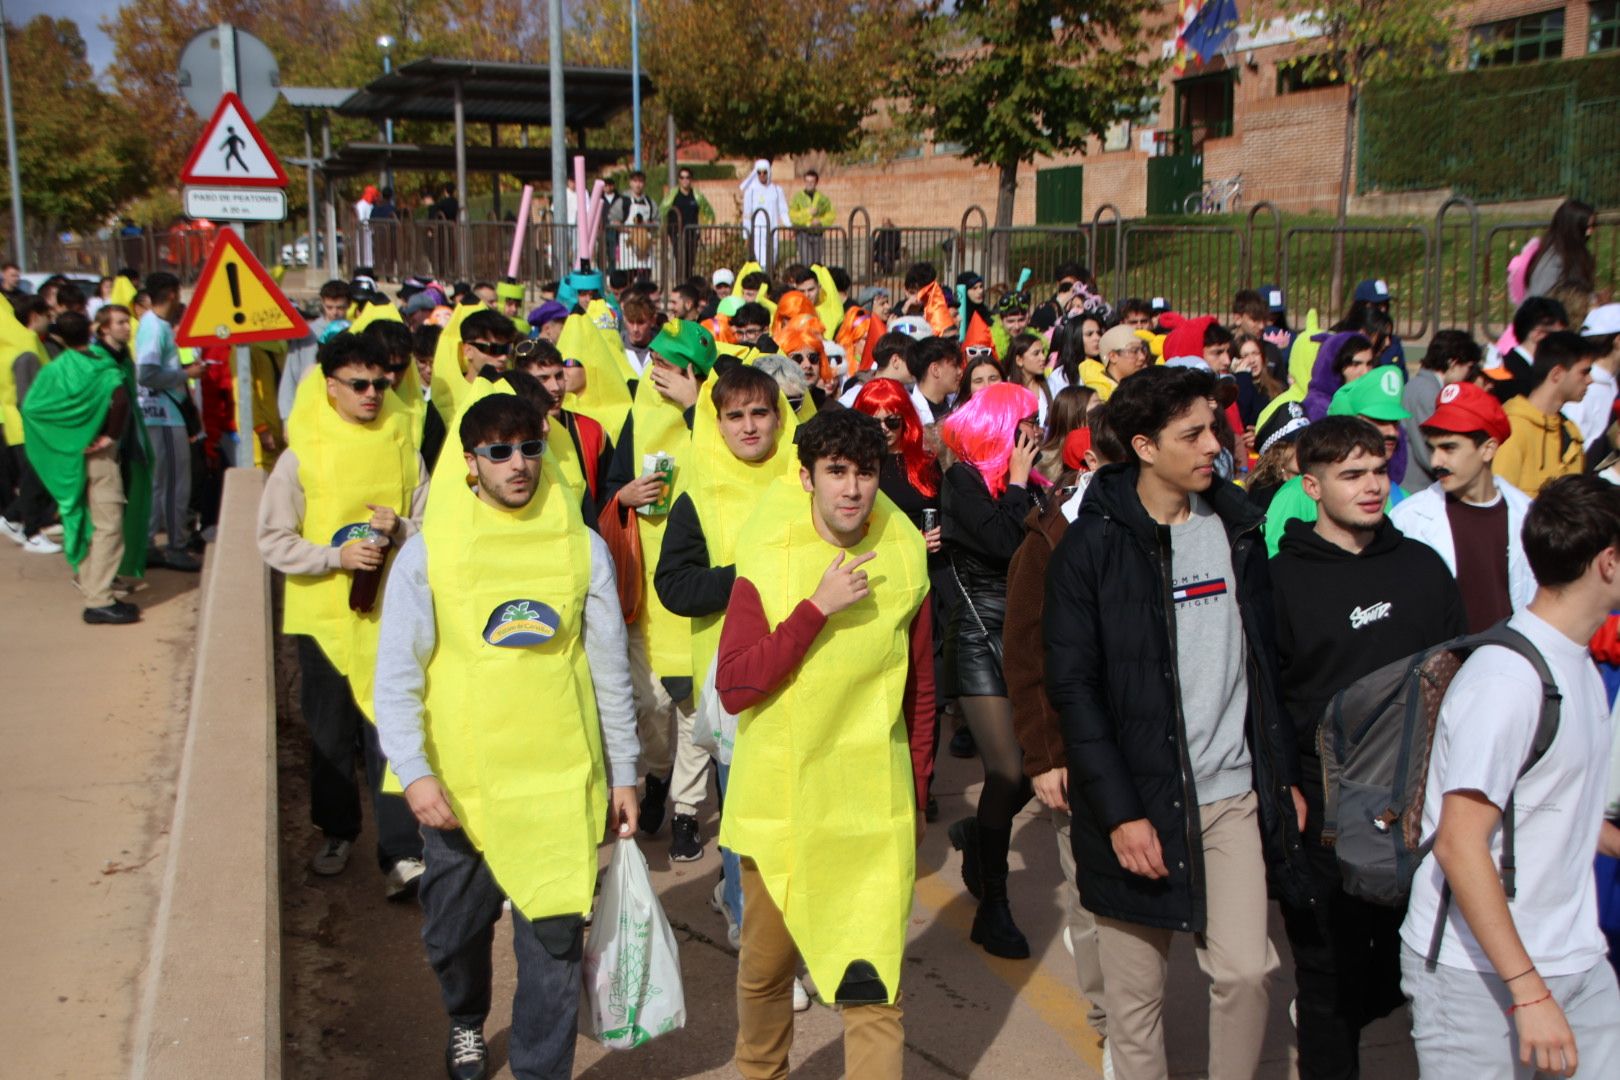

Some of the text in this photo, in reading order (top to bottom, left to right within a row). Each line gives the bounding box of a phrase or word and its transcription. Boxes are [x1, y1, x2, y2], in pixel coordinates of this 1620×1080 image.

[193, 193, 278, 203] PASO DE PEATONES
[1387, 373, 1396, 393] L
[1444, 386, 1456, 398] M
[1172, 573, 1209, 585] OMMY
[1177, 597, 1218, 609] FIGER
